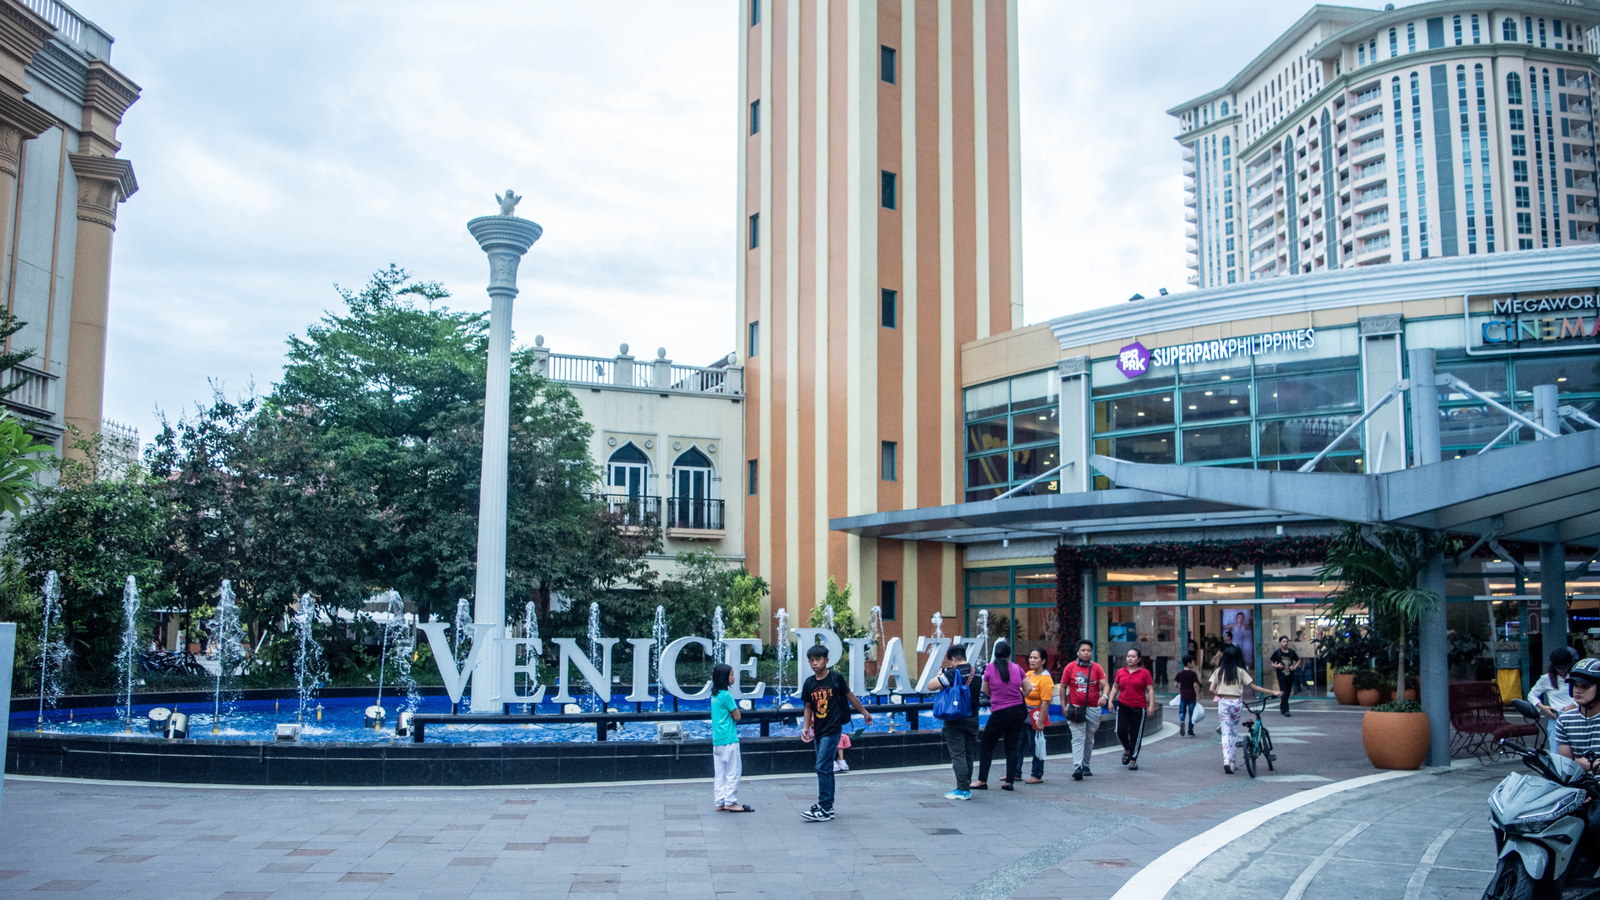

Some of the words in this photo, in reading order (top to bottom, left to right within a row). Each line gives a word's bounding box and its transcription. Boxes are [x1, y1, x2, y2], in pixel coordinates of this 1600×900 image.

[1120, 349, 1139, 362] SPR
[1122, 358, 1146, 370] PRK
[416, 622, 766, 703] VENICE
[790, 627, 1007, 698] PIAZZ
